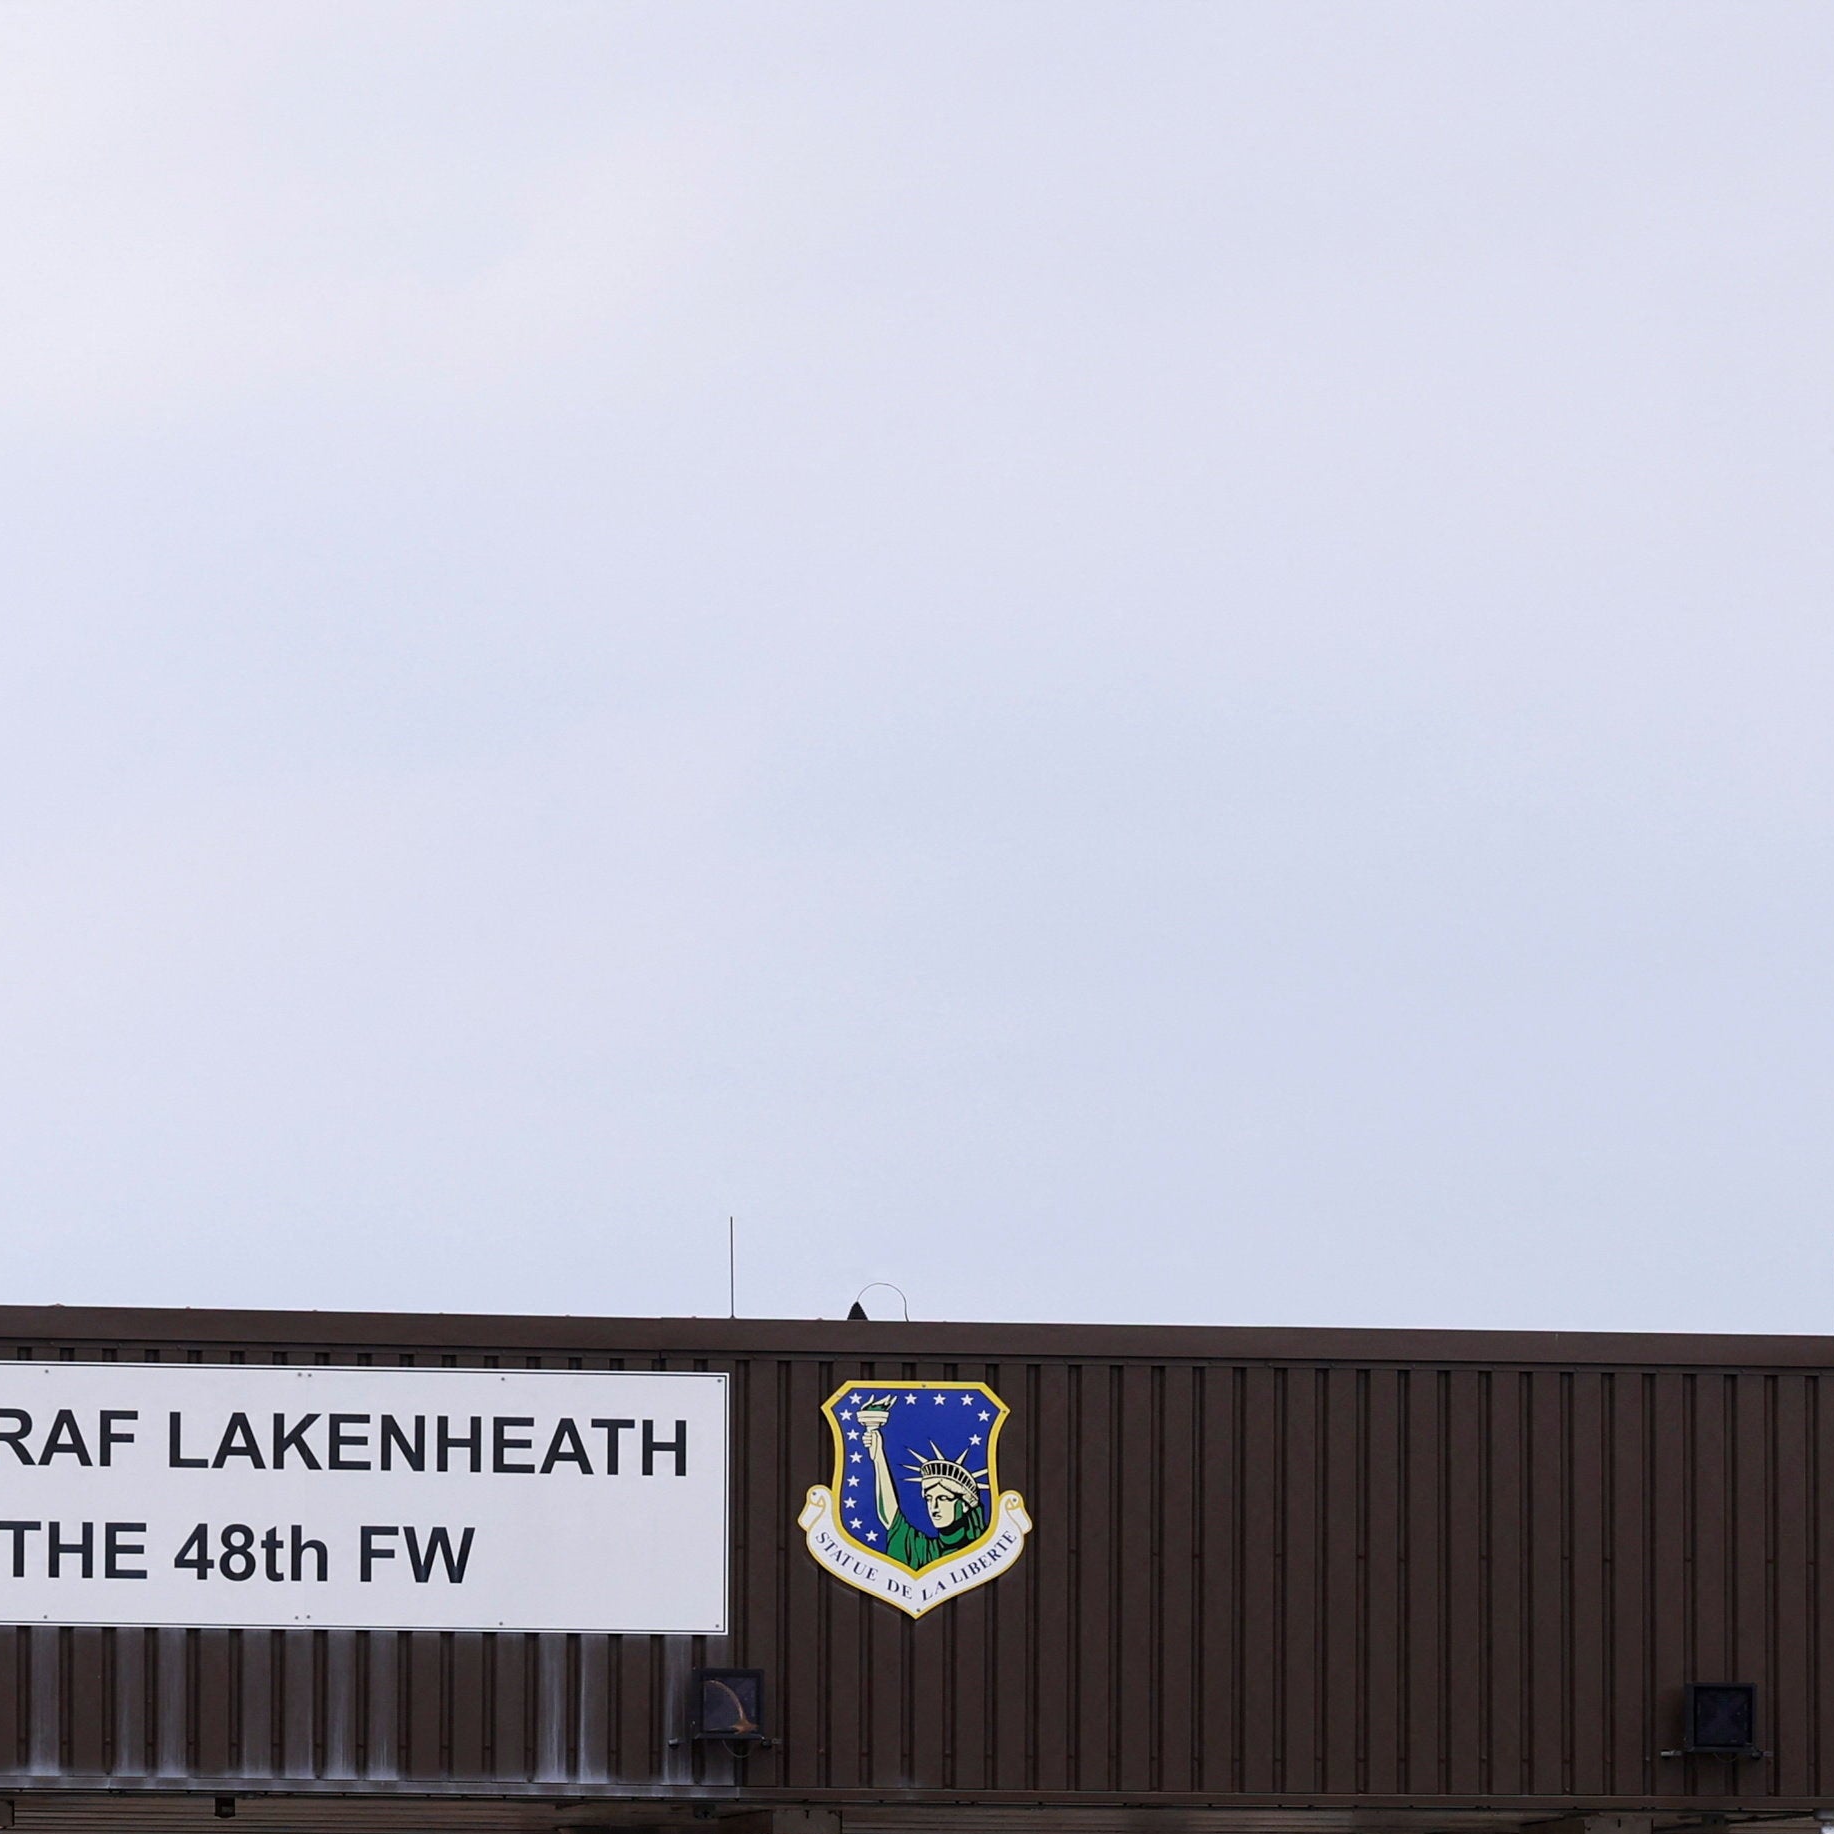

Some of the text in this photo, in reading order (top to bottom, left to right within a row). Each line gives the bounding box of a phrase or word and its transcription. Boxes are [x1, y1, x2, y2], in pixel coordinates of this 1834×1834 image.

[169, 1411, 687, 1476] LAKENHEATH
[174, 1524, 328, 1582] 48th
[360, 1526, 476, 1584] FW
[815, 1529, 1017, 1601] STATUE DE LA LIBERTE
